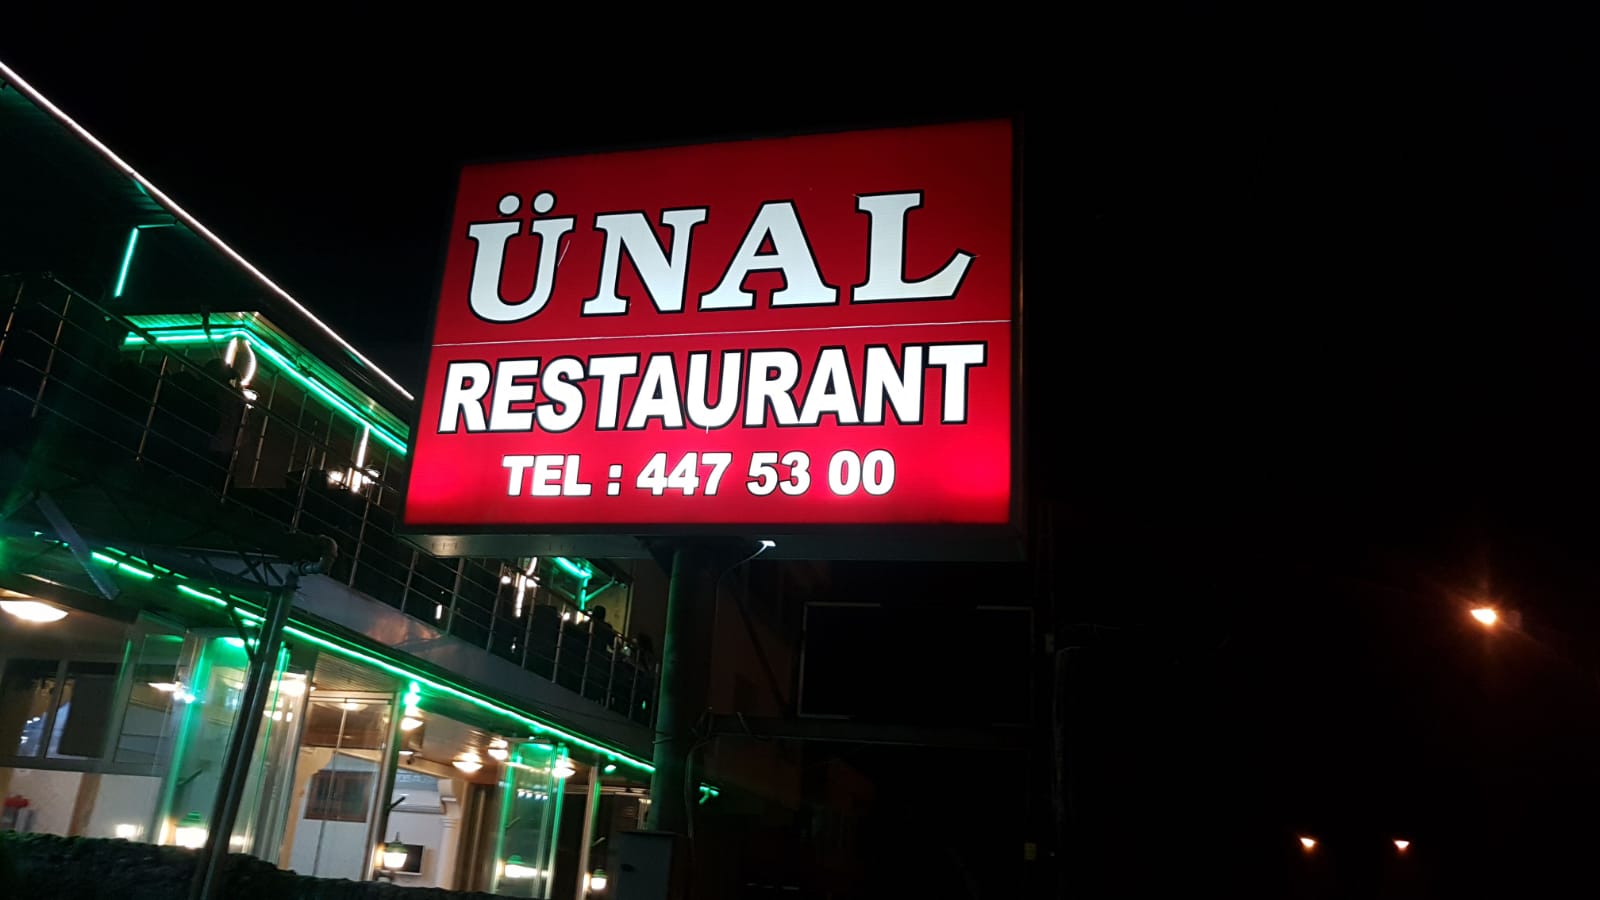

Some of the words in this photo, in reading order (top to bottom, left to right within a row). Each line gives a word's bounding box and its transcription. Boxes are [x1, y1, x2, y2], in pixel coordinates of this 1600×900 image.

[468, 191, 973, 323] ÜNAL
[437, 342, 987, 434] RESTAURANT
[502, 453, 593, 497] TEL
[636, 451, 732, 497] 447
[746, 451, 812, 497] 53
[827, 449, 896, 497] 00
